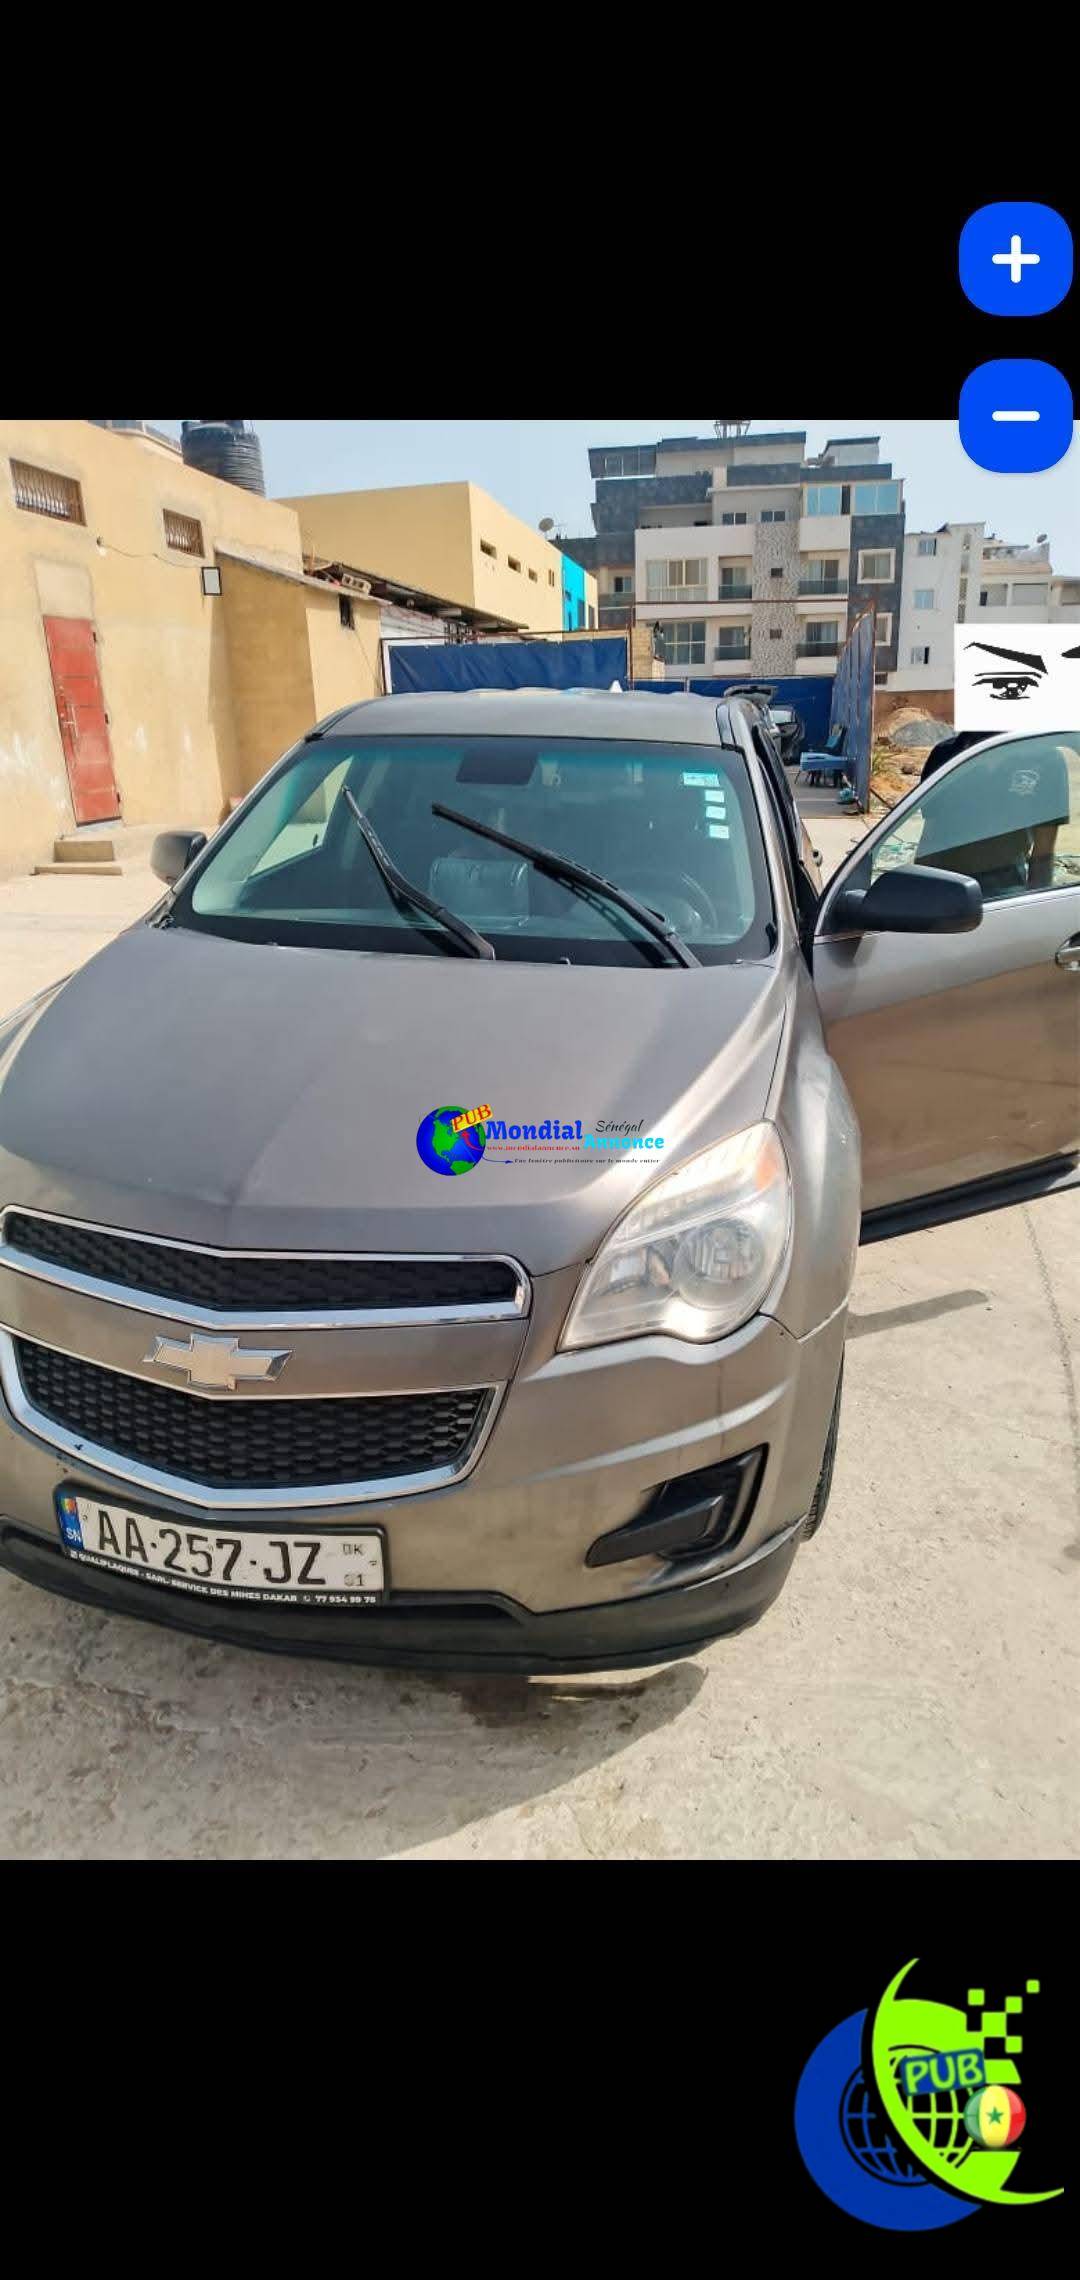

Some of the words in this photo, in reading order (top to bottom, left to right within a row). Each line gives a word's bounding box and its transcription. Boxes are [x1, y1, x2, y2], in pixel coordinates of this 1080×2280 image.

[66, 1527, 81, 1543] SN
[171, 1580, 208, 1594] SERVICE
[210, 1587, 229, 1597] DES
[231, 1590, 261, 1600] MINES
[263, 1593, 297, 1602] DAKAR
